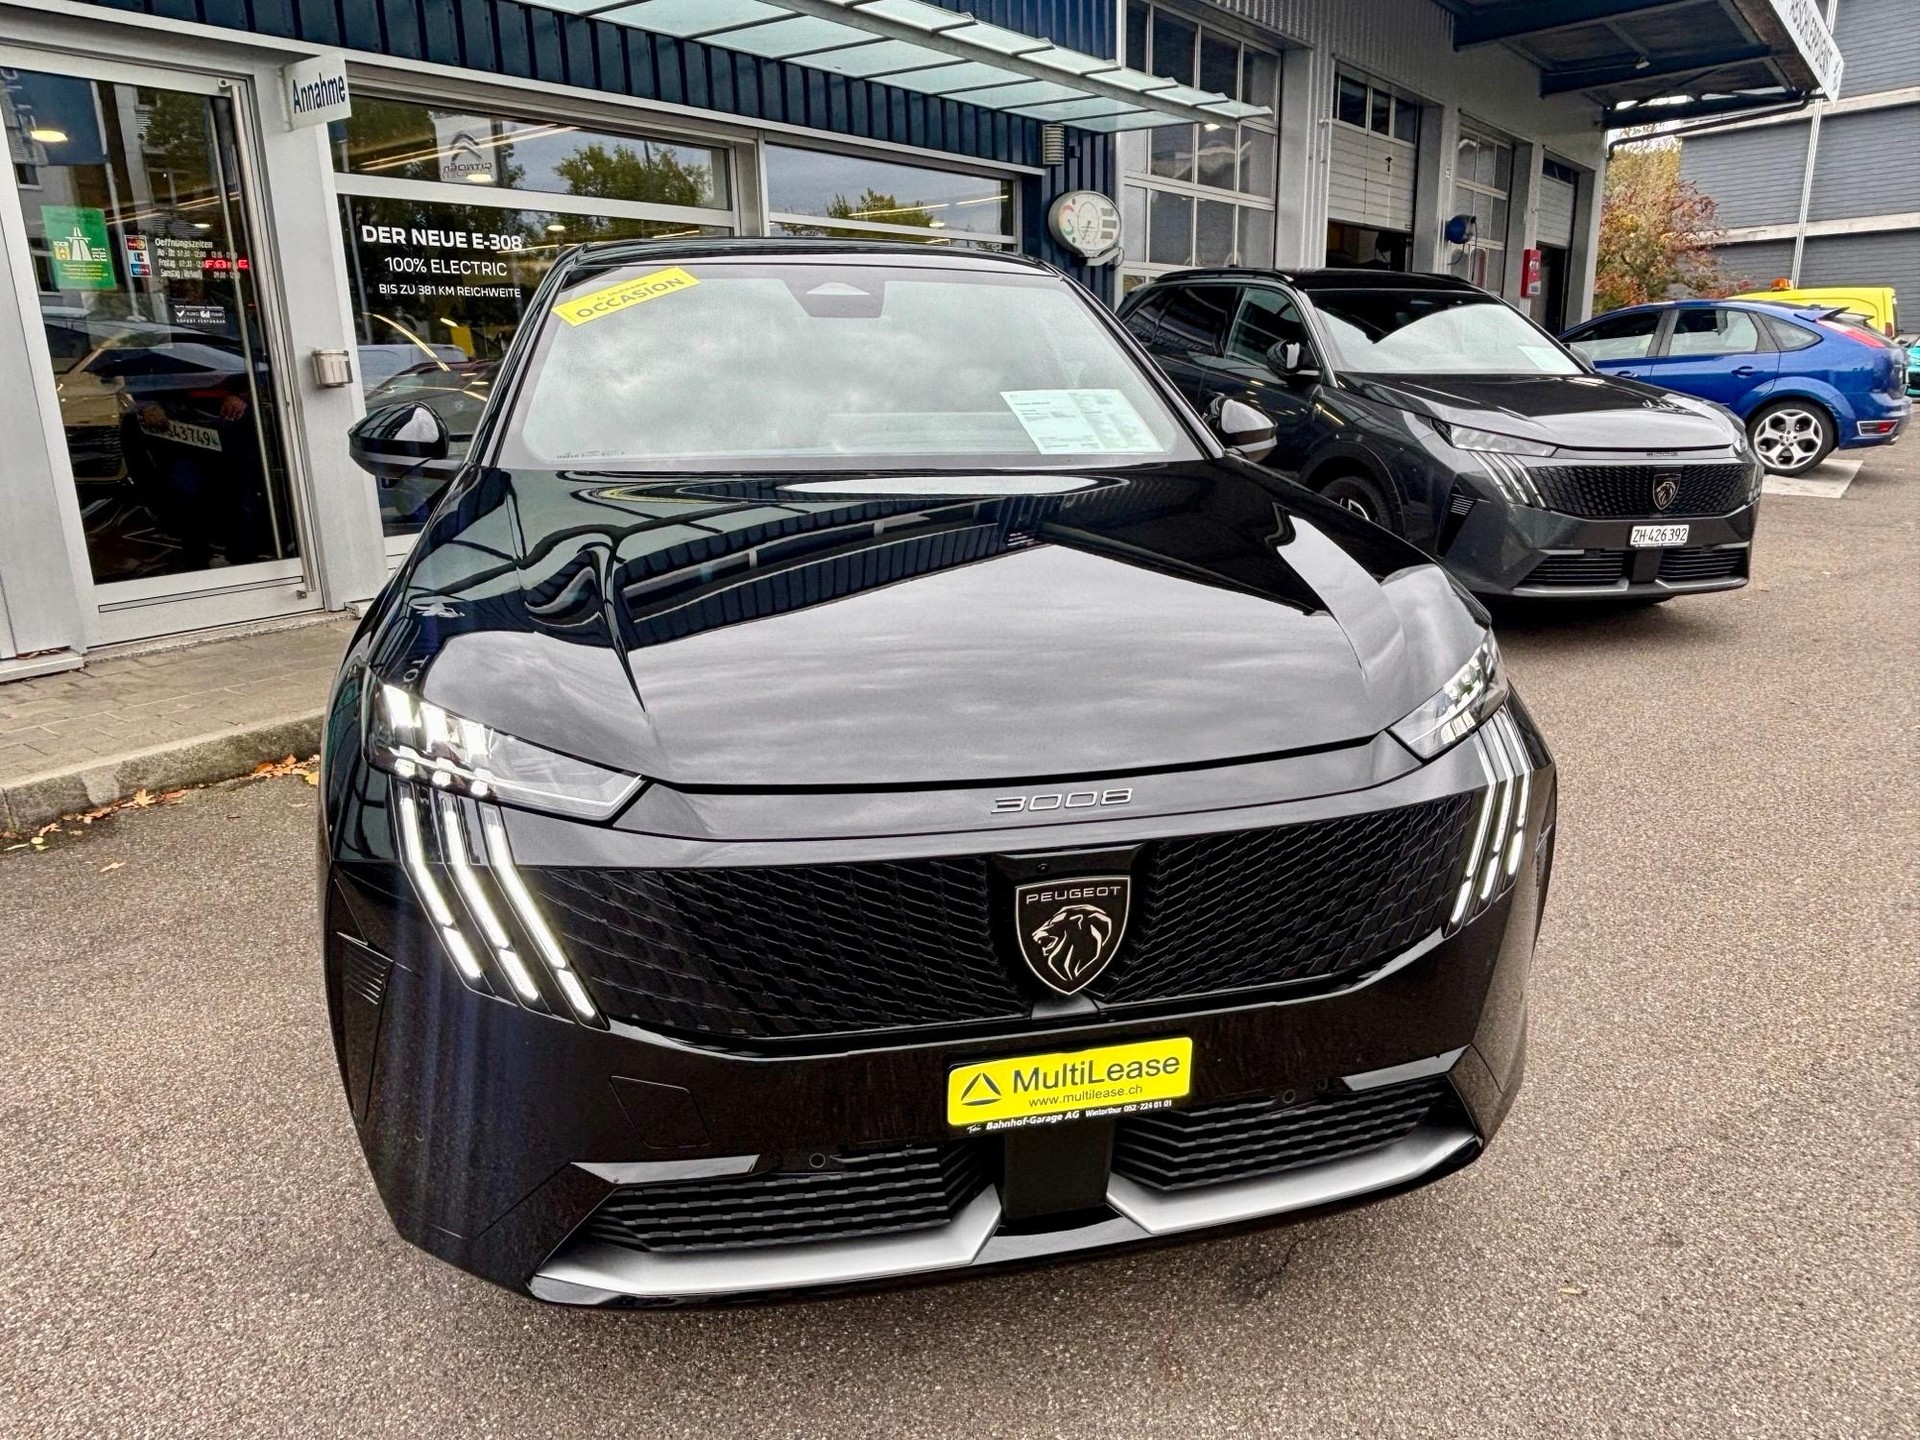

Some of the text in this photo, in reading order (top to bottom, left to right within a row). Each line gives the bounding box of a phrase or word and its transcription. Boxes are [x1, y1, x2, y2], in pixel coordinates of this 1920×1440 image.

[292, 72, 346, 114] Annahme
[361, 225, 523, 250] DER NEUE E-308
[384, 256, 508, 276] 100% ELECTRIC
[378, 283, 521, 298] BIS ZU 381 KM REICHWEITE
[576, 278, 685, 318] OCCASION
[991, 787, 1133, 815] 3008
[1026, 886, 1122, 905] PEUGEOT
[1013, 1056, 1180, 1094] MultiLease
[1028, 1084, 1143, 1107] www.multilease.ch
[986, 1114, 1063, 1130] Bahnhof-Garage
[1064, 1110, 1080, 1120] AG
[1085, 1107, 1122, 1117] Winterthur
